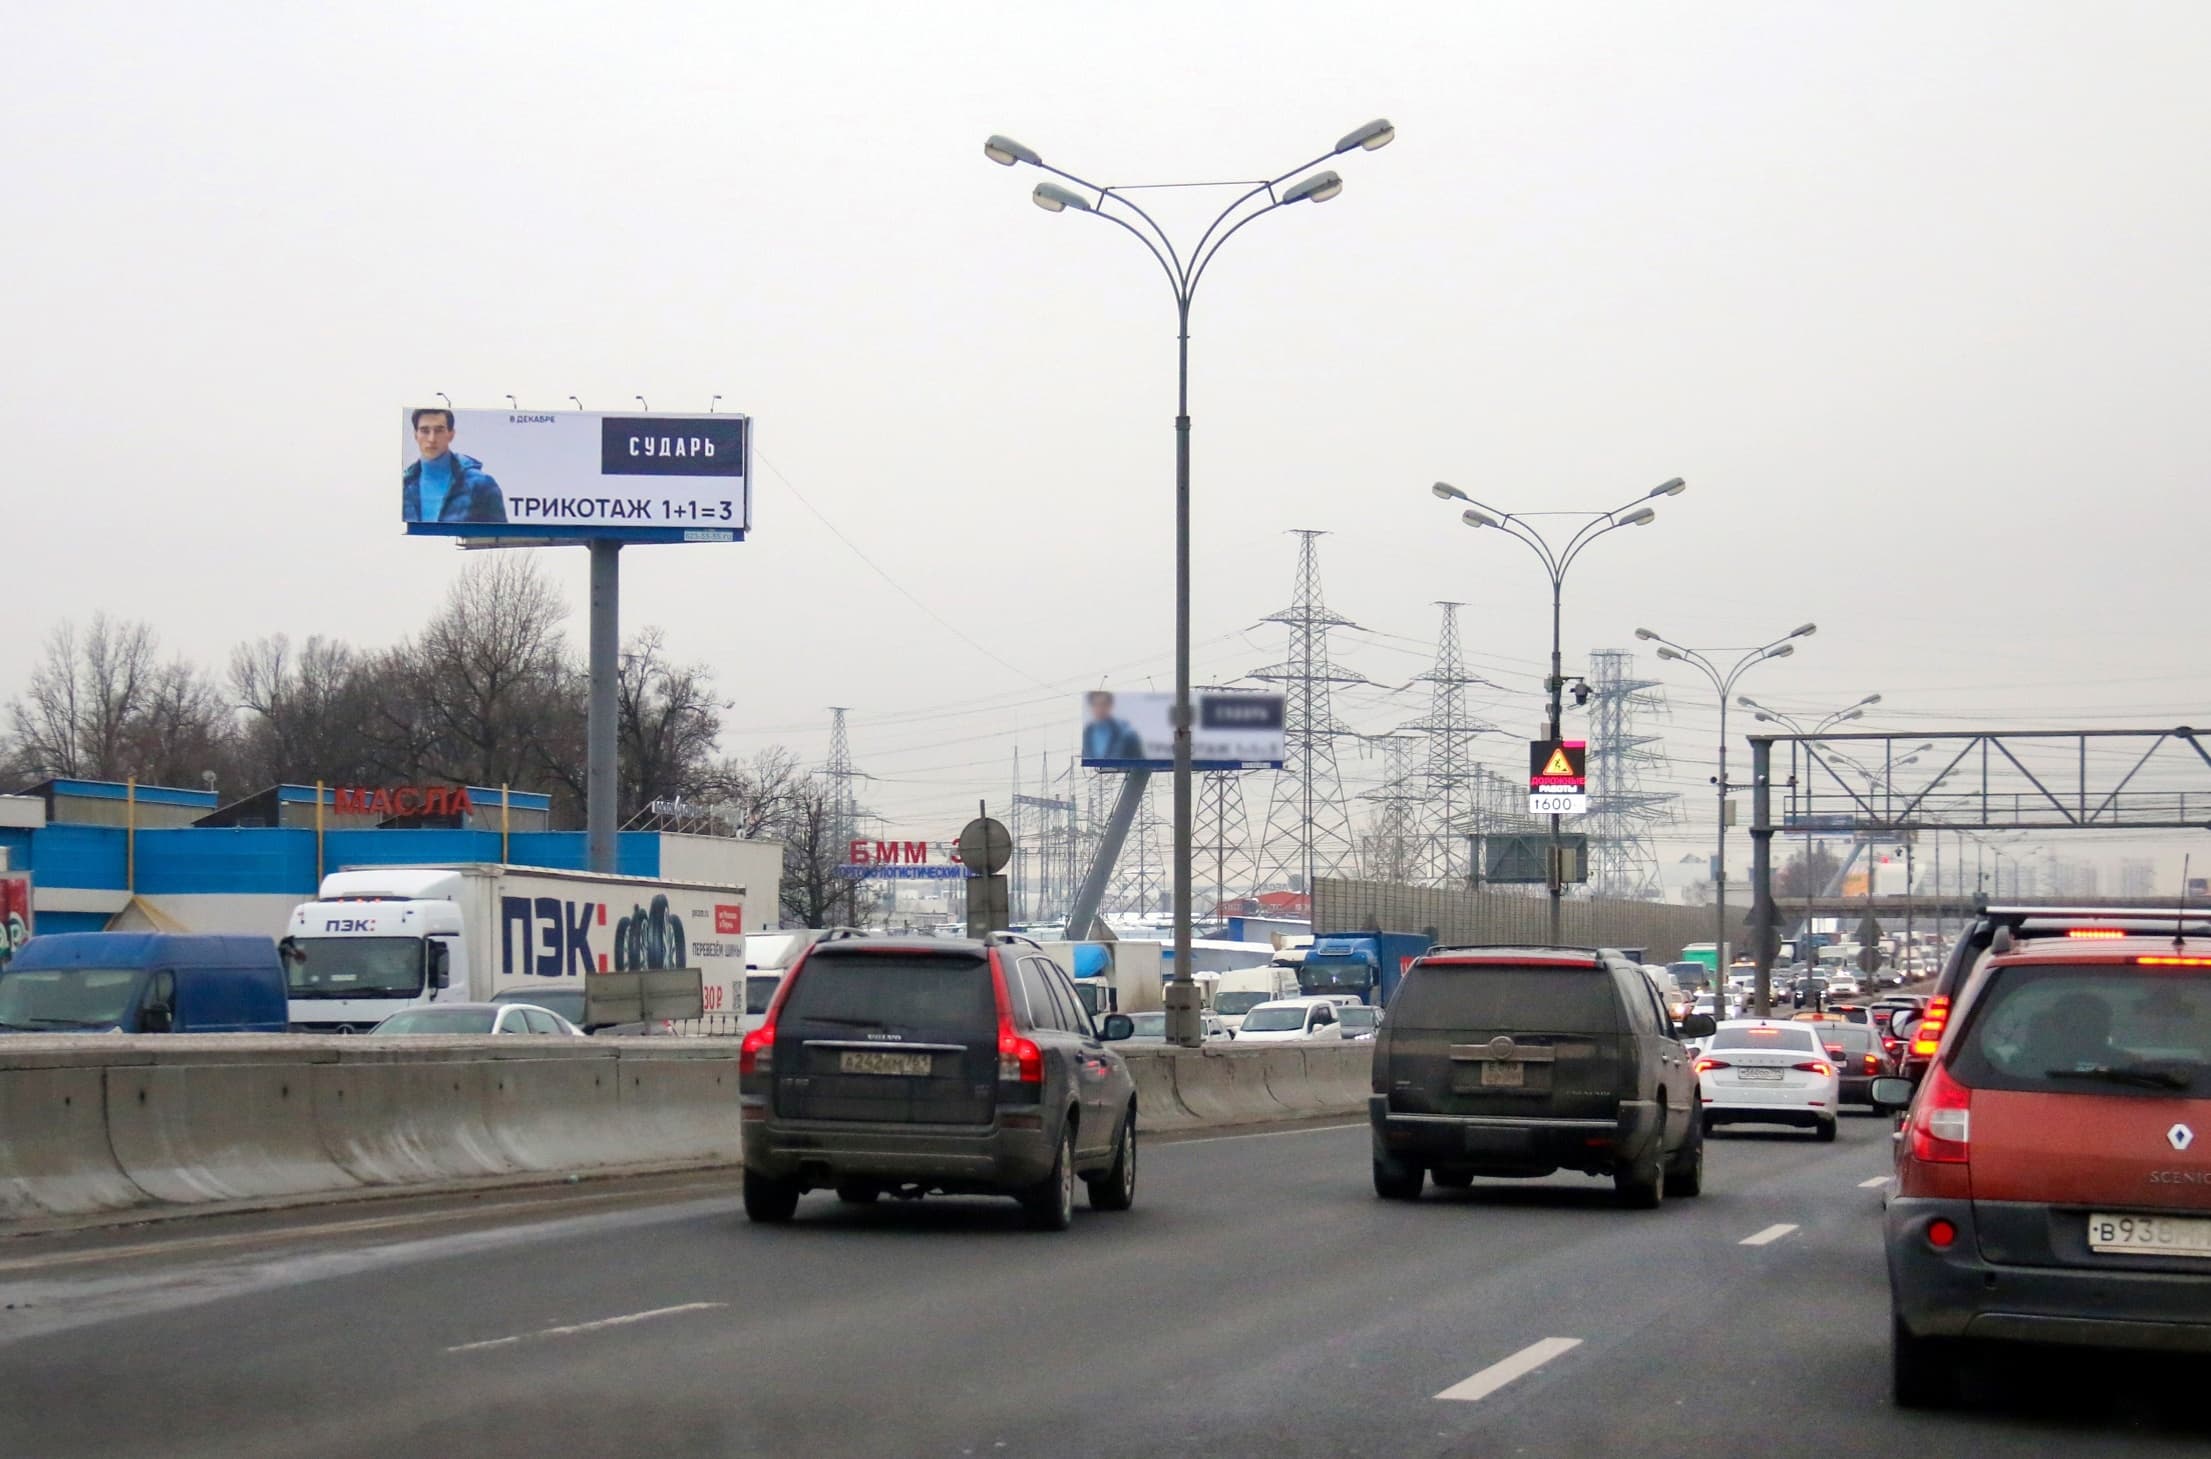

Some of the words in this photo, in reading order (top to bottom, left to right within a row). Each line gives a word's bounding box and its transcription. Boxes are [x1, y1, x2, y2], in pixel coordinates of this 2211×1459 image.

[517, 415, 555, 424] ДЕКАБРЕ
[629, 436, 715, 457] СУДАРЬ
[509, 497, 651, 519] ТРИКОТАЖ
[662, 499, 733, 521] 1+1=3
[1531, 776, 1586, 786] ДОРОЖНЫЕ
[1539, 785, 1578, 793] РАБОТЫ
[334, 785, 475, 817] МАСЛА
[850, 840, 927, 865] БММ
[2149, 1171, 2211, 1185] SCENIC
